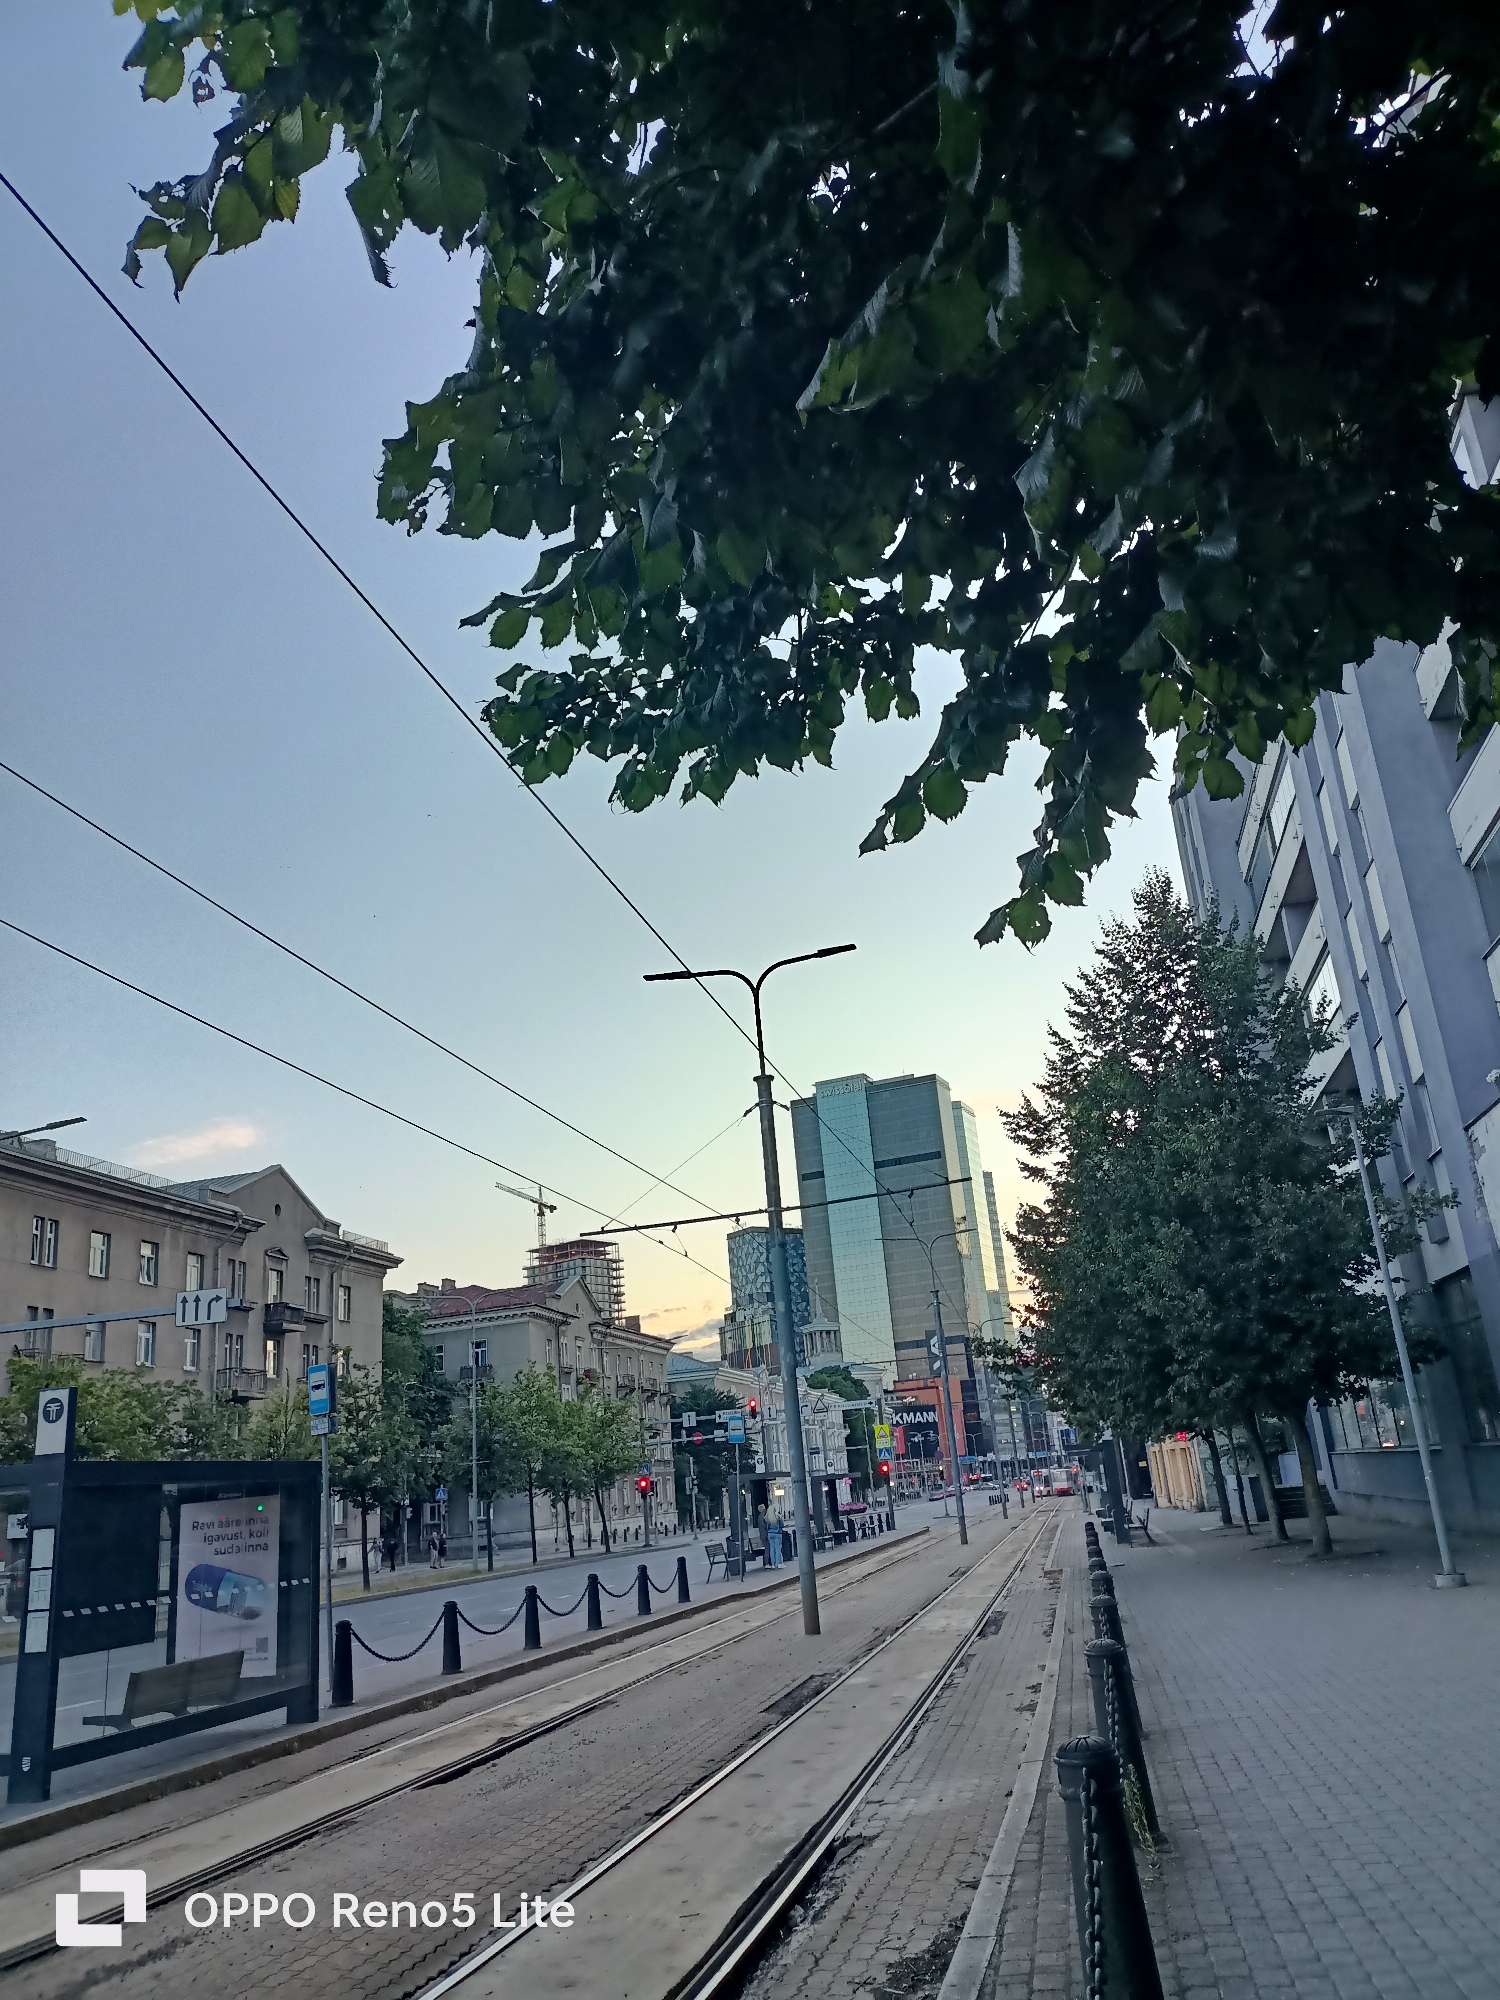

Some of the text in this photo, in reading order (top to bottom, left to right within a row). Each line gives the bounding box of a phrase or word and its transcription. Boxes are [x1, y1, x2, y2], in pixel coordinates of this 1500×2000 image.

[892, 1411, 938, 1424] KMANN
[191, 1520, 215, 1531] Ravi
[203, 1531, 246, 1546] igavust,
